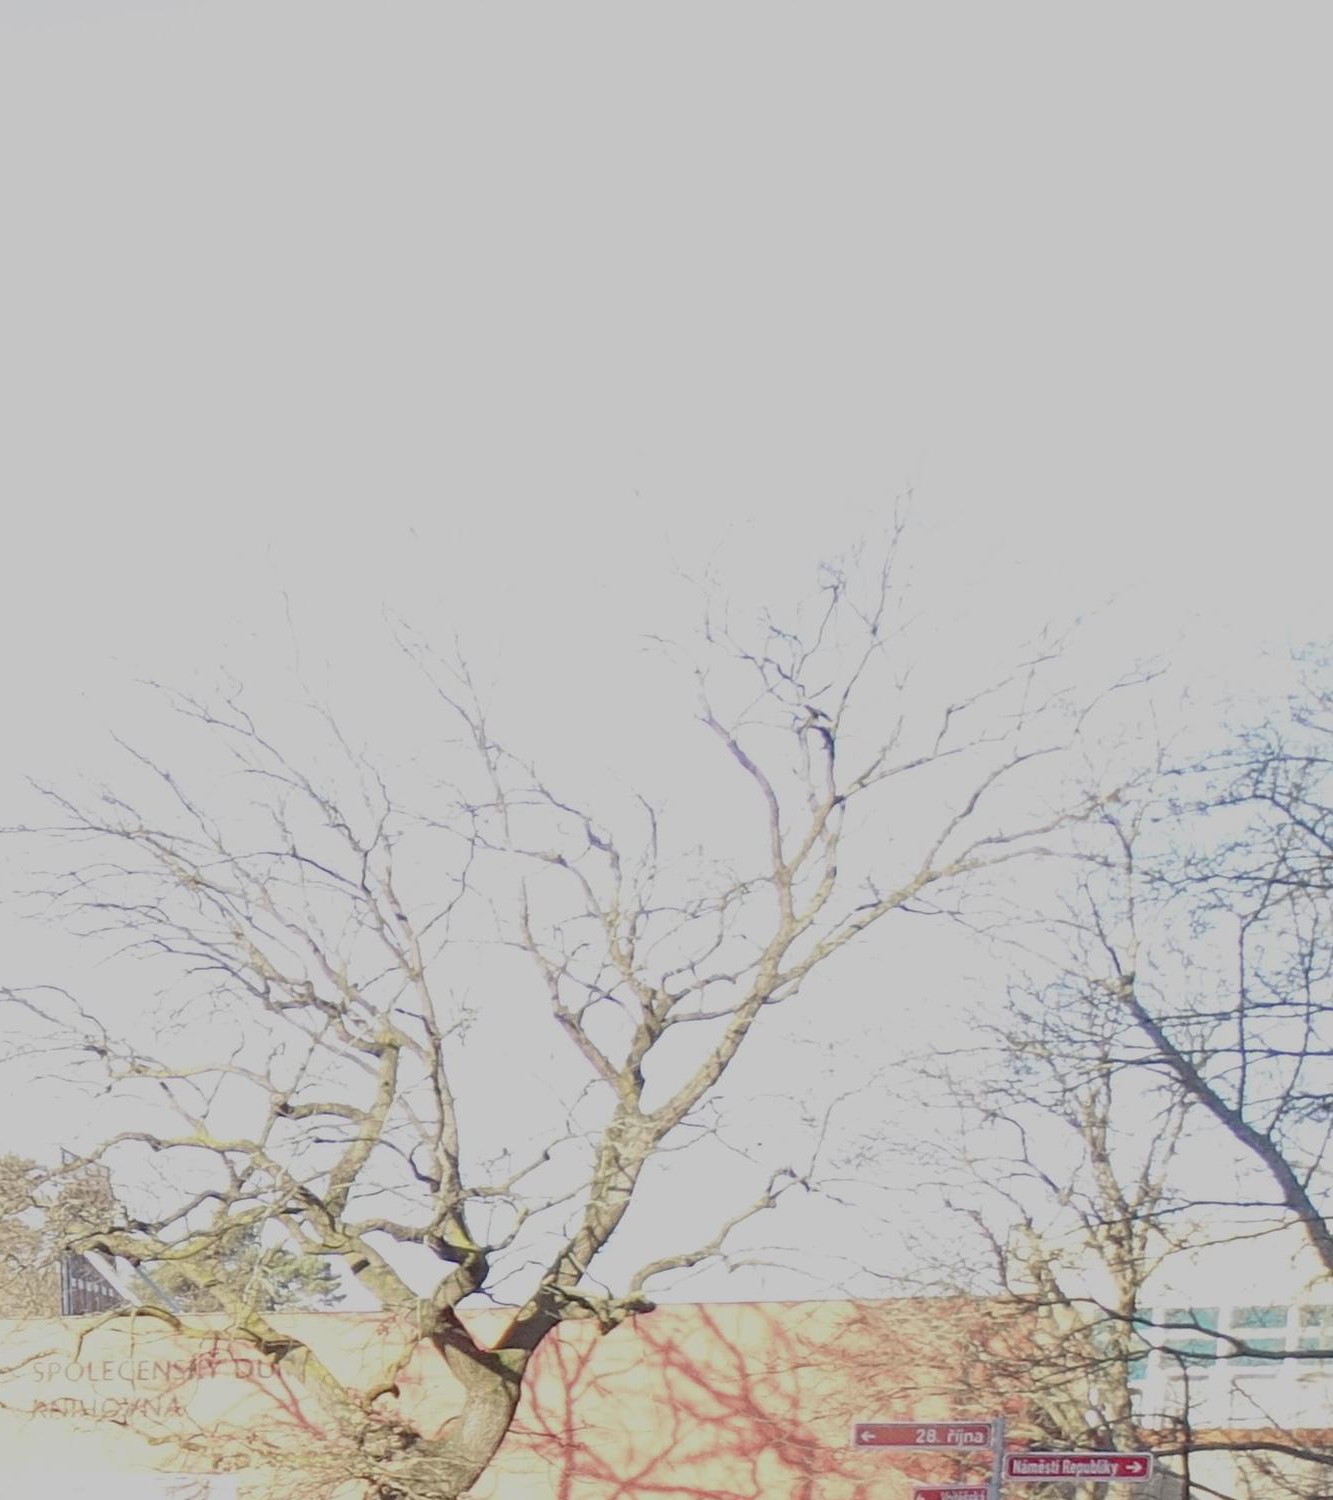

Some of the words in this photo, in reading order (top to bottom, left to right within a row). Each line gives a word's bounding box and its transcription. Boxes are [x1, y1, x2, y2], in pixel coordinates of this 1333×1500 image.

[916, 1428, 941, 1444] 28.
[947, 1427, 984, 1447] října
[1012, 1458, 1060, 1475] Náměstí
[1062, 1458, 1119, 1478] Republiky
